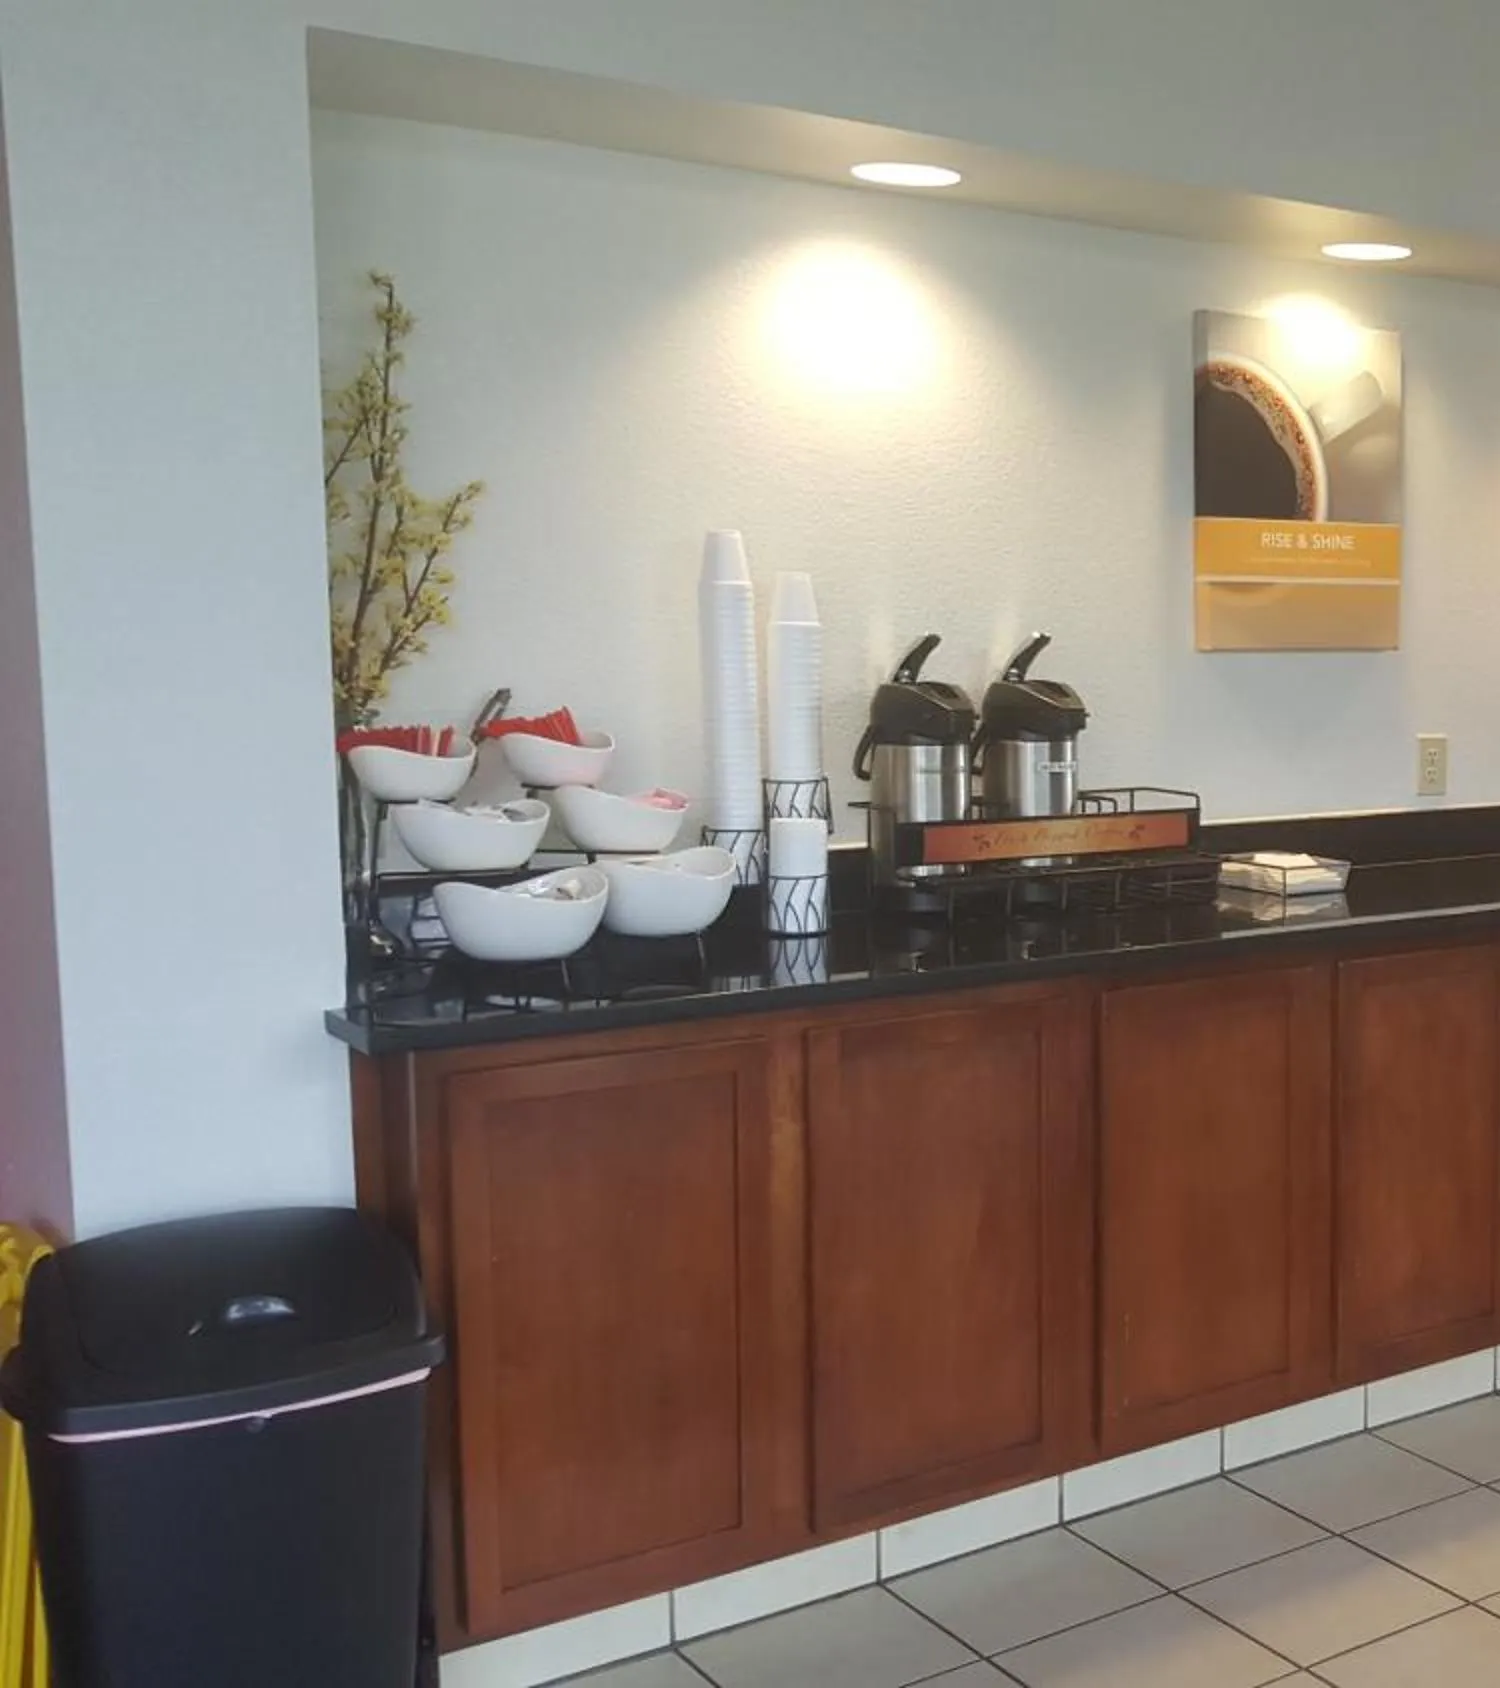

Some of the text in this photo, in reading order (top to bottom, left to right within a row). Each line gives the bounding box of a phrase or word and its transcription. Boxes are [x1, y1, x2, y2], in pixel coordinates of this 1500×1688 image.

[1261, 532, 1355, 550] RISE & SHINE
